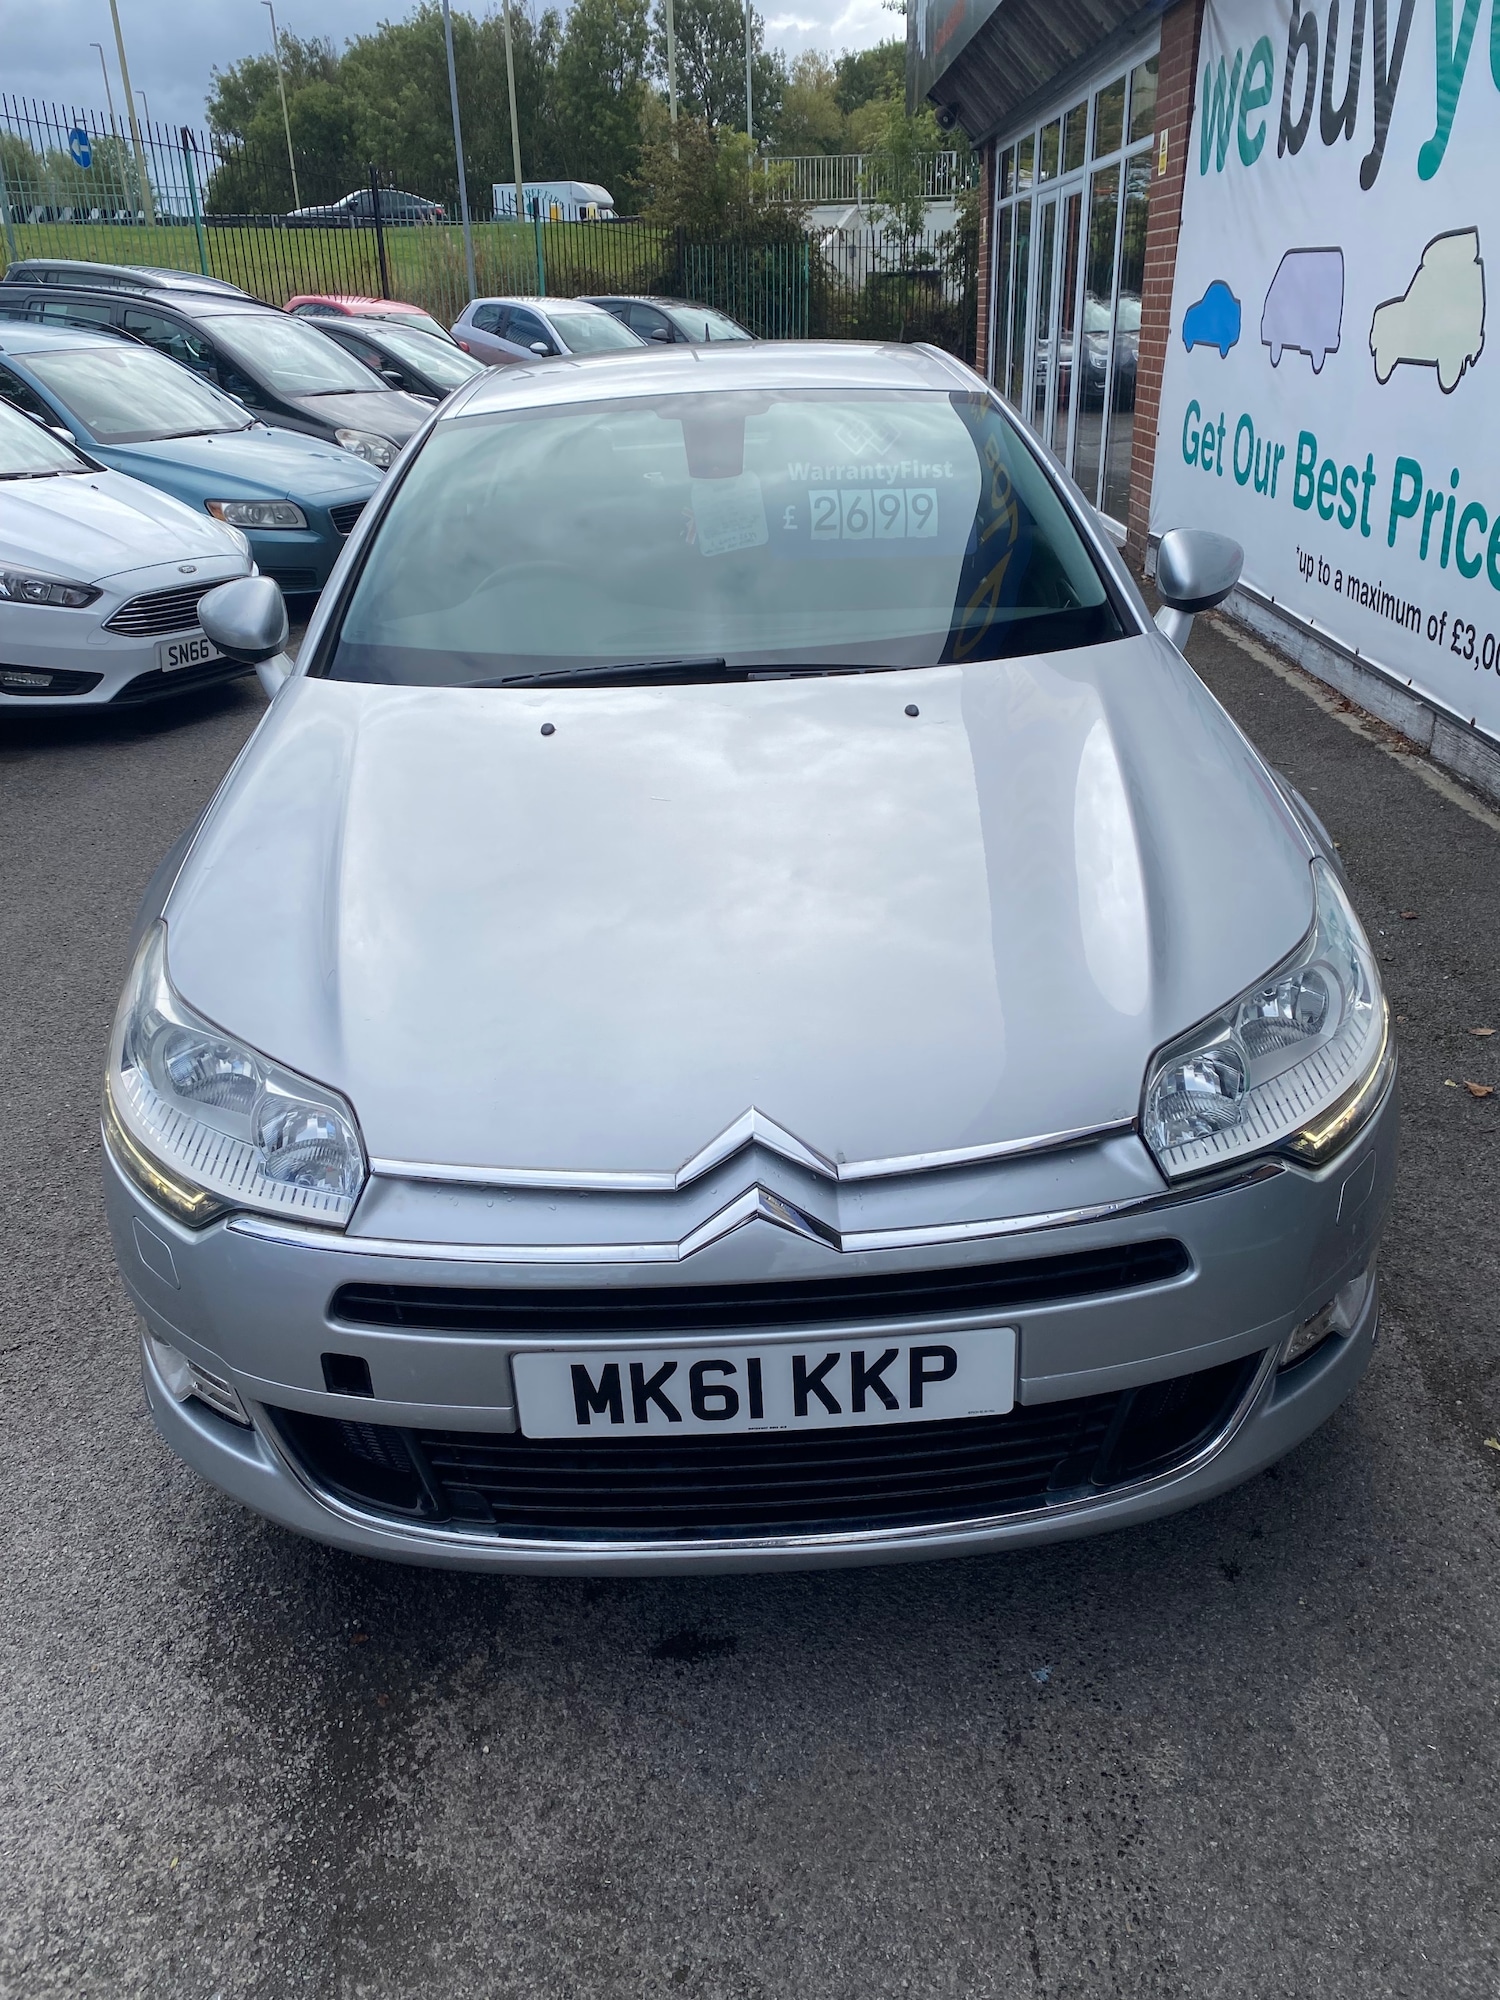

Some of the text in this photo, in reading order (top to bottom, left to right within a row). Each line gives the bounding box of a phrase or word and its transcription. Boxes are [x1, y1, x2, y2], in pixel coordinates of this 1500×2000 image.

[1417, 0, 1500, 181] y
[787, 460, 954, 486] WarrantyFirst
[1182, 399, 1226, 477] Get
[1233, 413, 1285, 499] Our
[1293, 430, 1376, 538] Best
[813, 493, 934, 533] 2699
[1318, 558, 1331, 586] to
[1334, 569, 1343, 590] a
[1347, 580, 1422, 634] maximum
[1427, 611, 1448, 646] of
[168, 638, 209, 667] SN66
[570, 1344, 958, 1425] MK61 KKP
